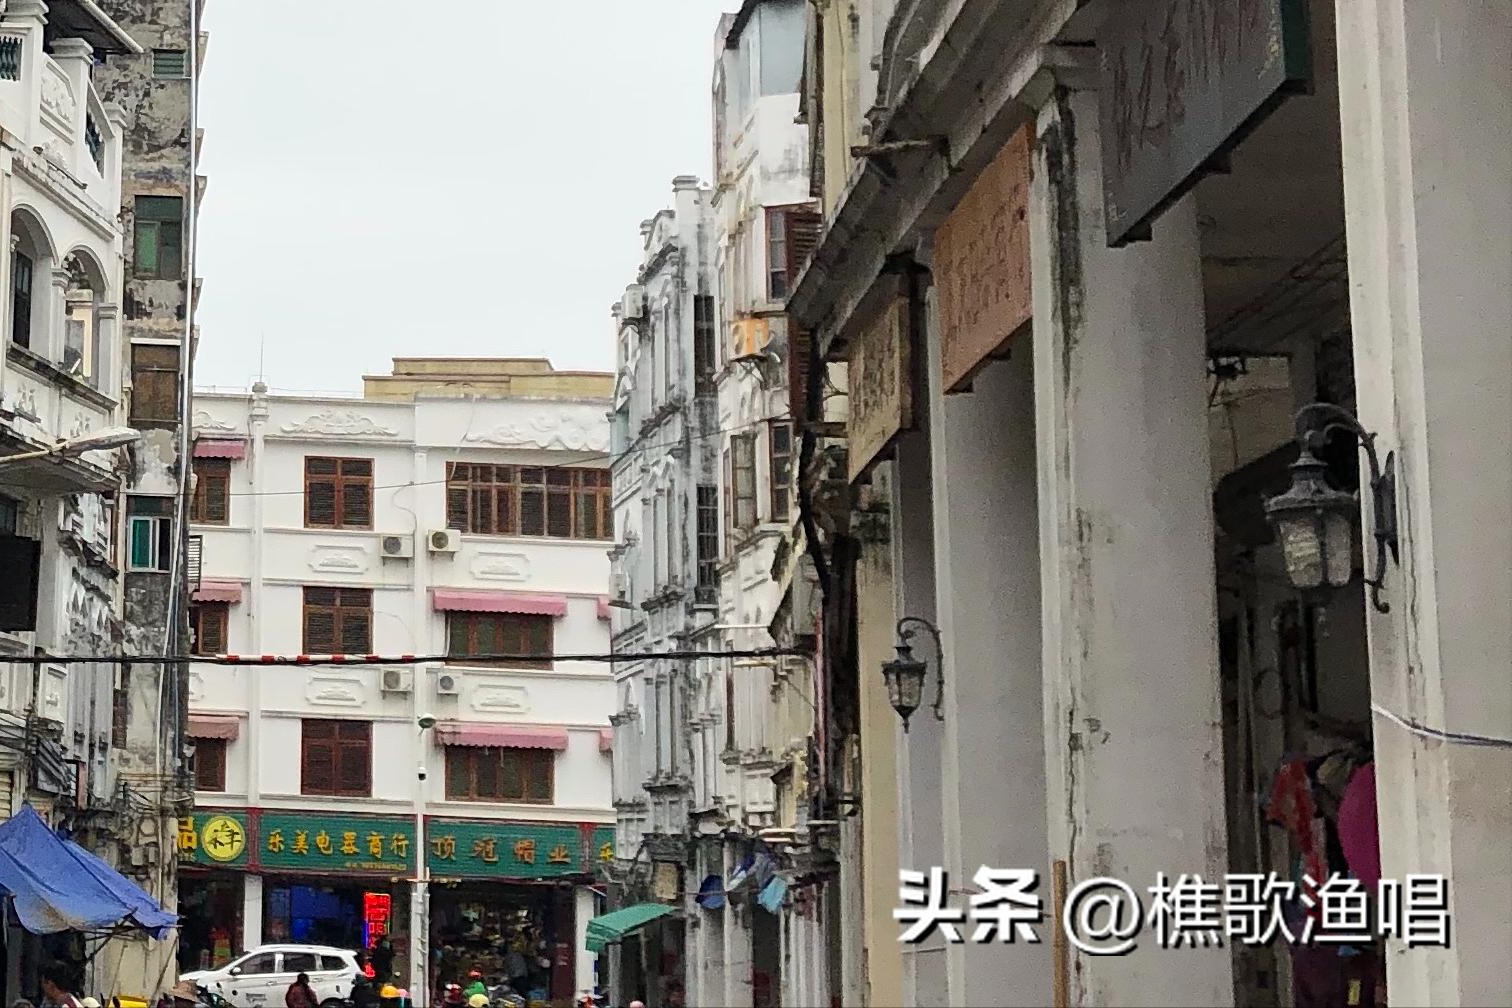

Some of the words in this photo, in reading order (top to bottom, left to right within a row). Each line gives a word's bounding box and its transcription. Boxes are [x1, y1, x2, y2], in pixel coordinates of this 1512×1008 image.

[267, 828, 410, 859] 乐美电器商行
[430, 834, 572, 865] 顶冠帽业
